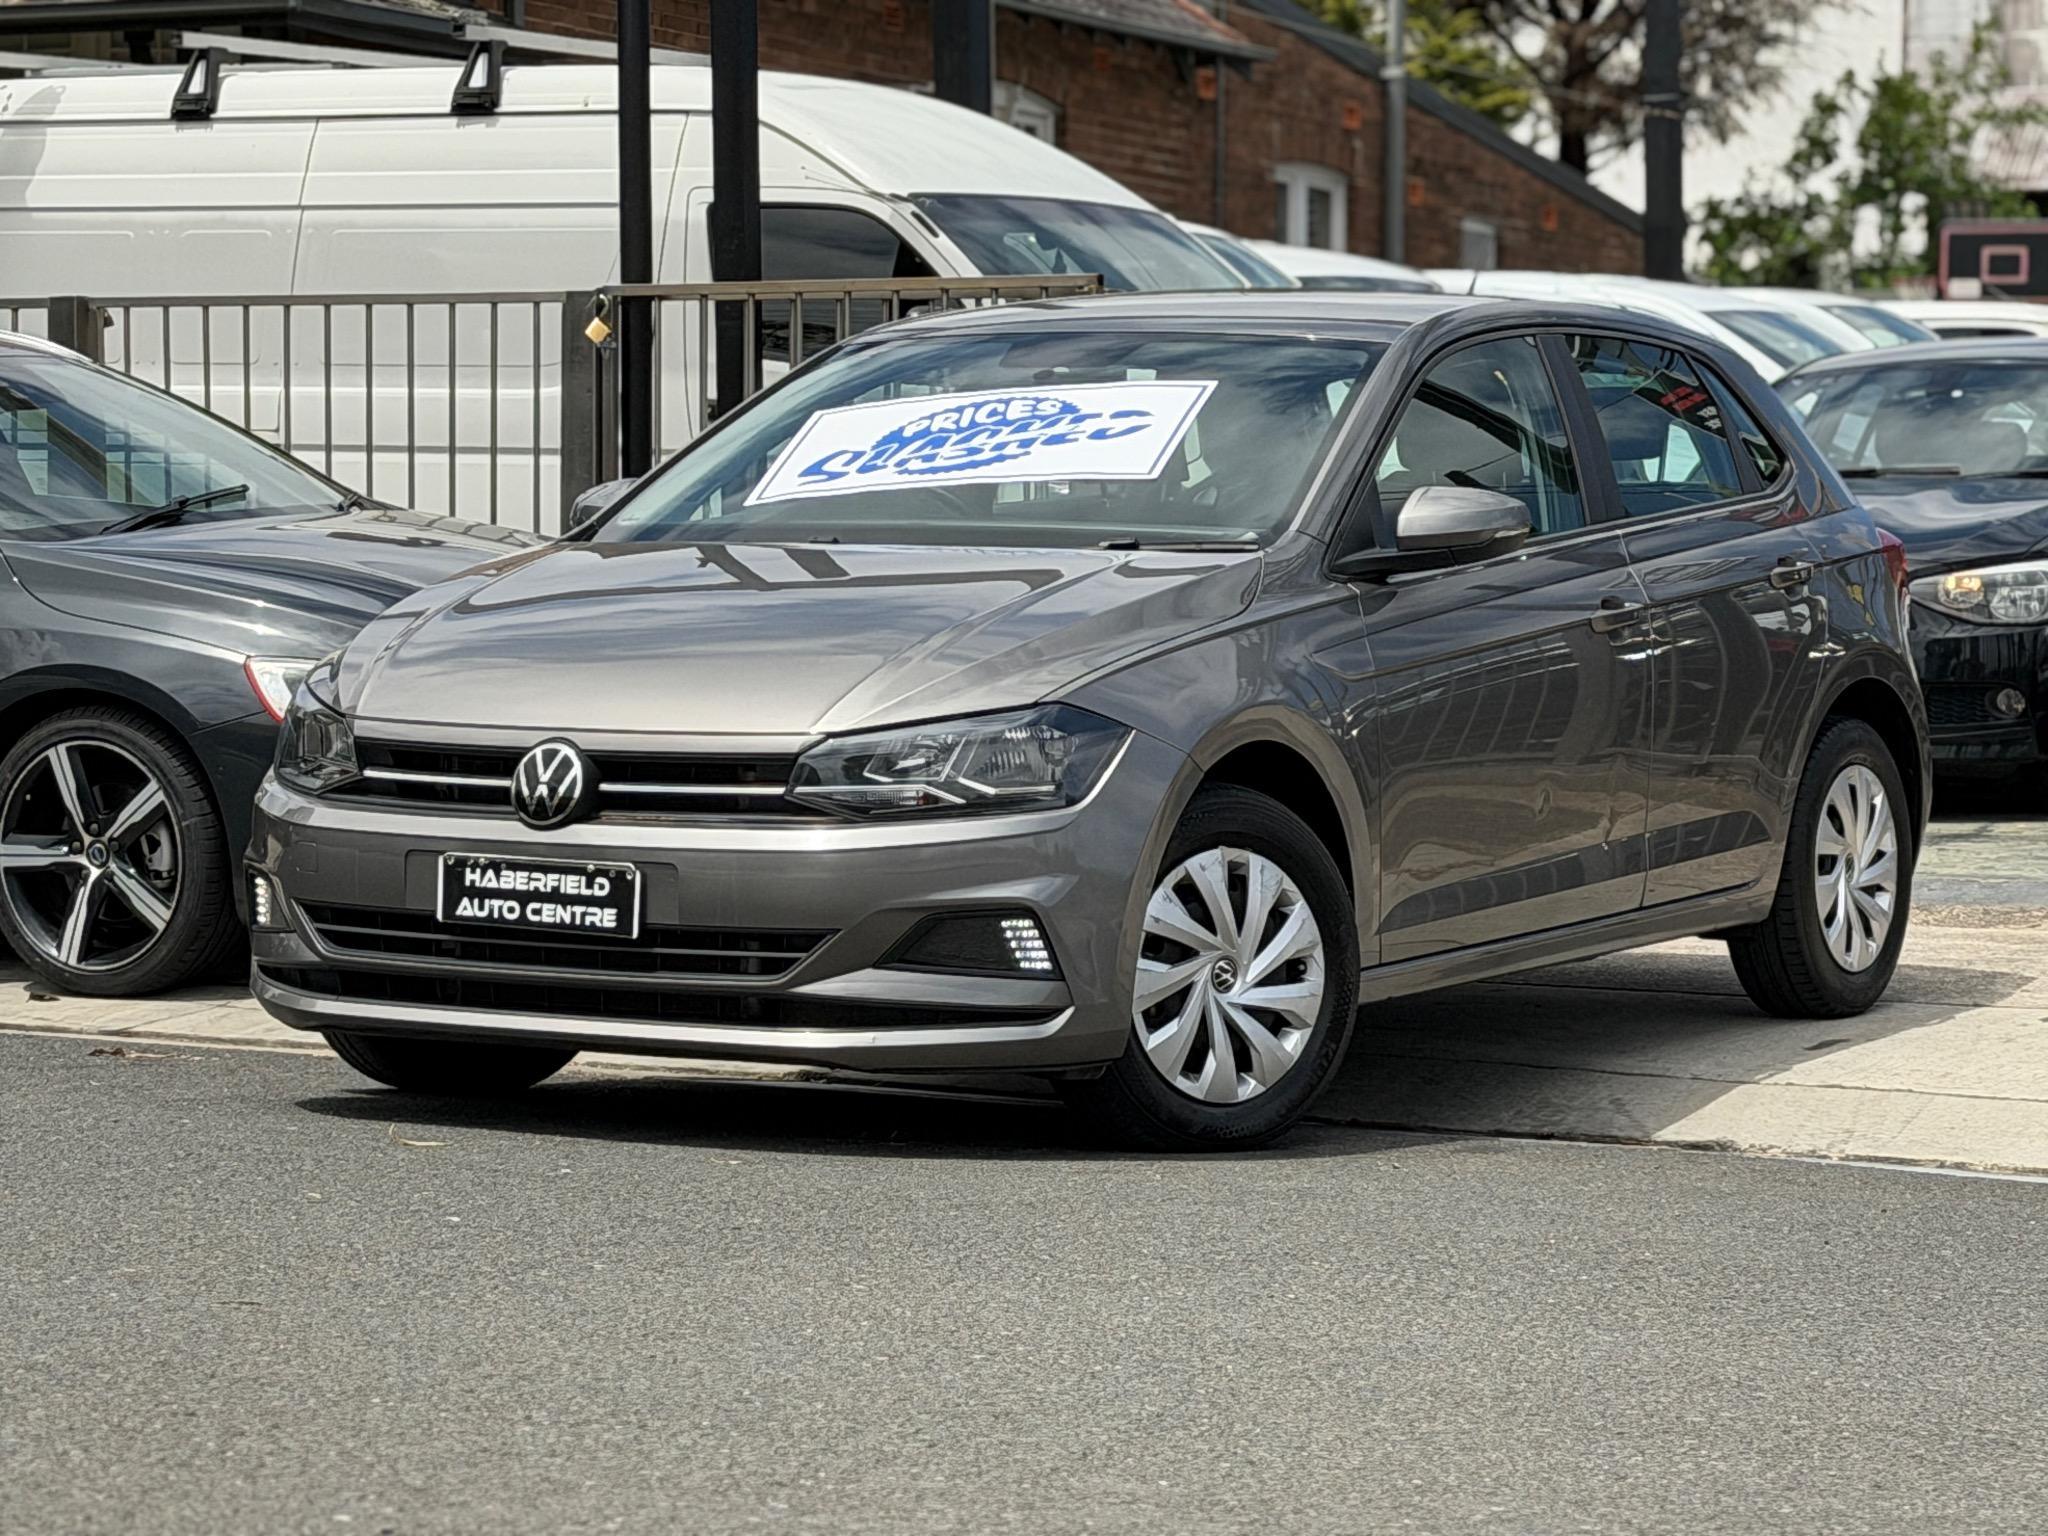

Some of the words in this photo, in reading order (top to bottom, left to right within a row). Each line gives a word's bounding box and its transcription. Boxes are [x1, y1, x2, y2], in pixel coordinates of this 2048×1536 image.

[902, 399, 1063, 438] PRICES
[464, 867, 611, 897] HABERFIELD
[455, 896, 521, 920] AUTO
[525, 901, 619, 928] CENTRE
